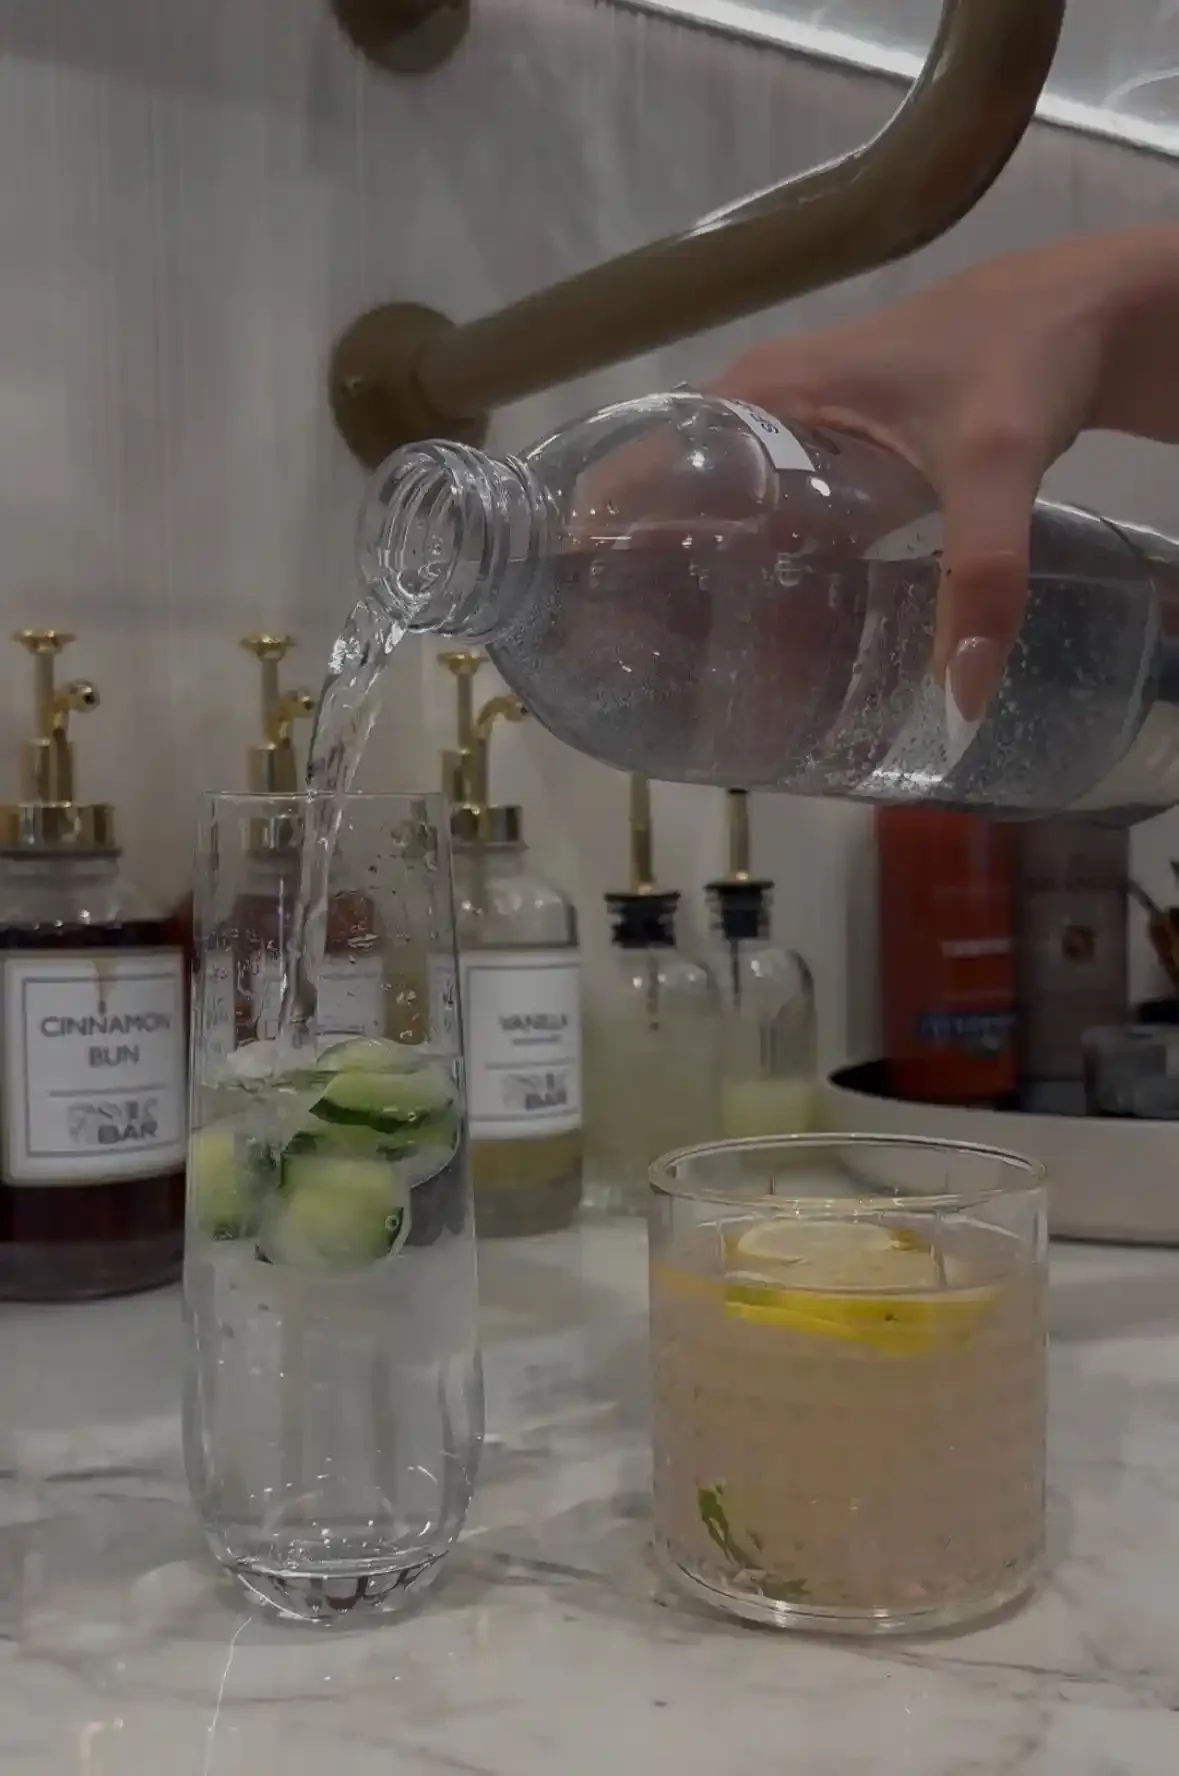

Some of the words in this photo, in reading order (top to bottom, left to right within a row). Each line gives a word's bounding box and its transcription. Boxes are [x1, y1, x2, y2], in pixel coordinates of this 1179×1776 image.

[40, 1011, 172, 1037] CINNAMON
[88, 1045, 141, 1068] BUN
[98, 1121, 158, 1144] BAR
